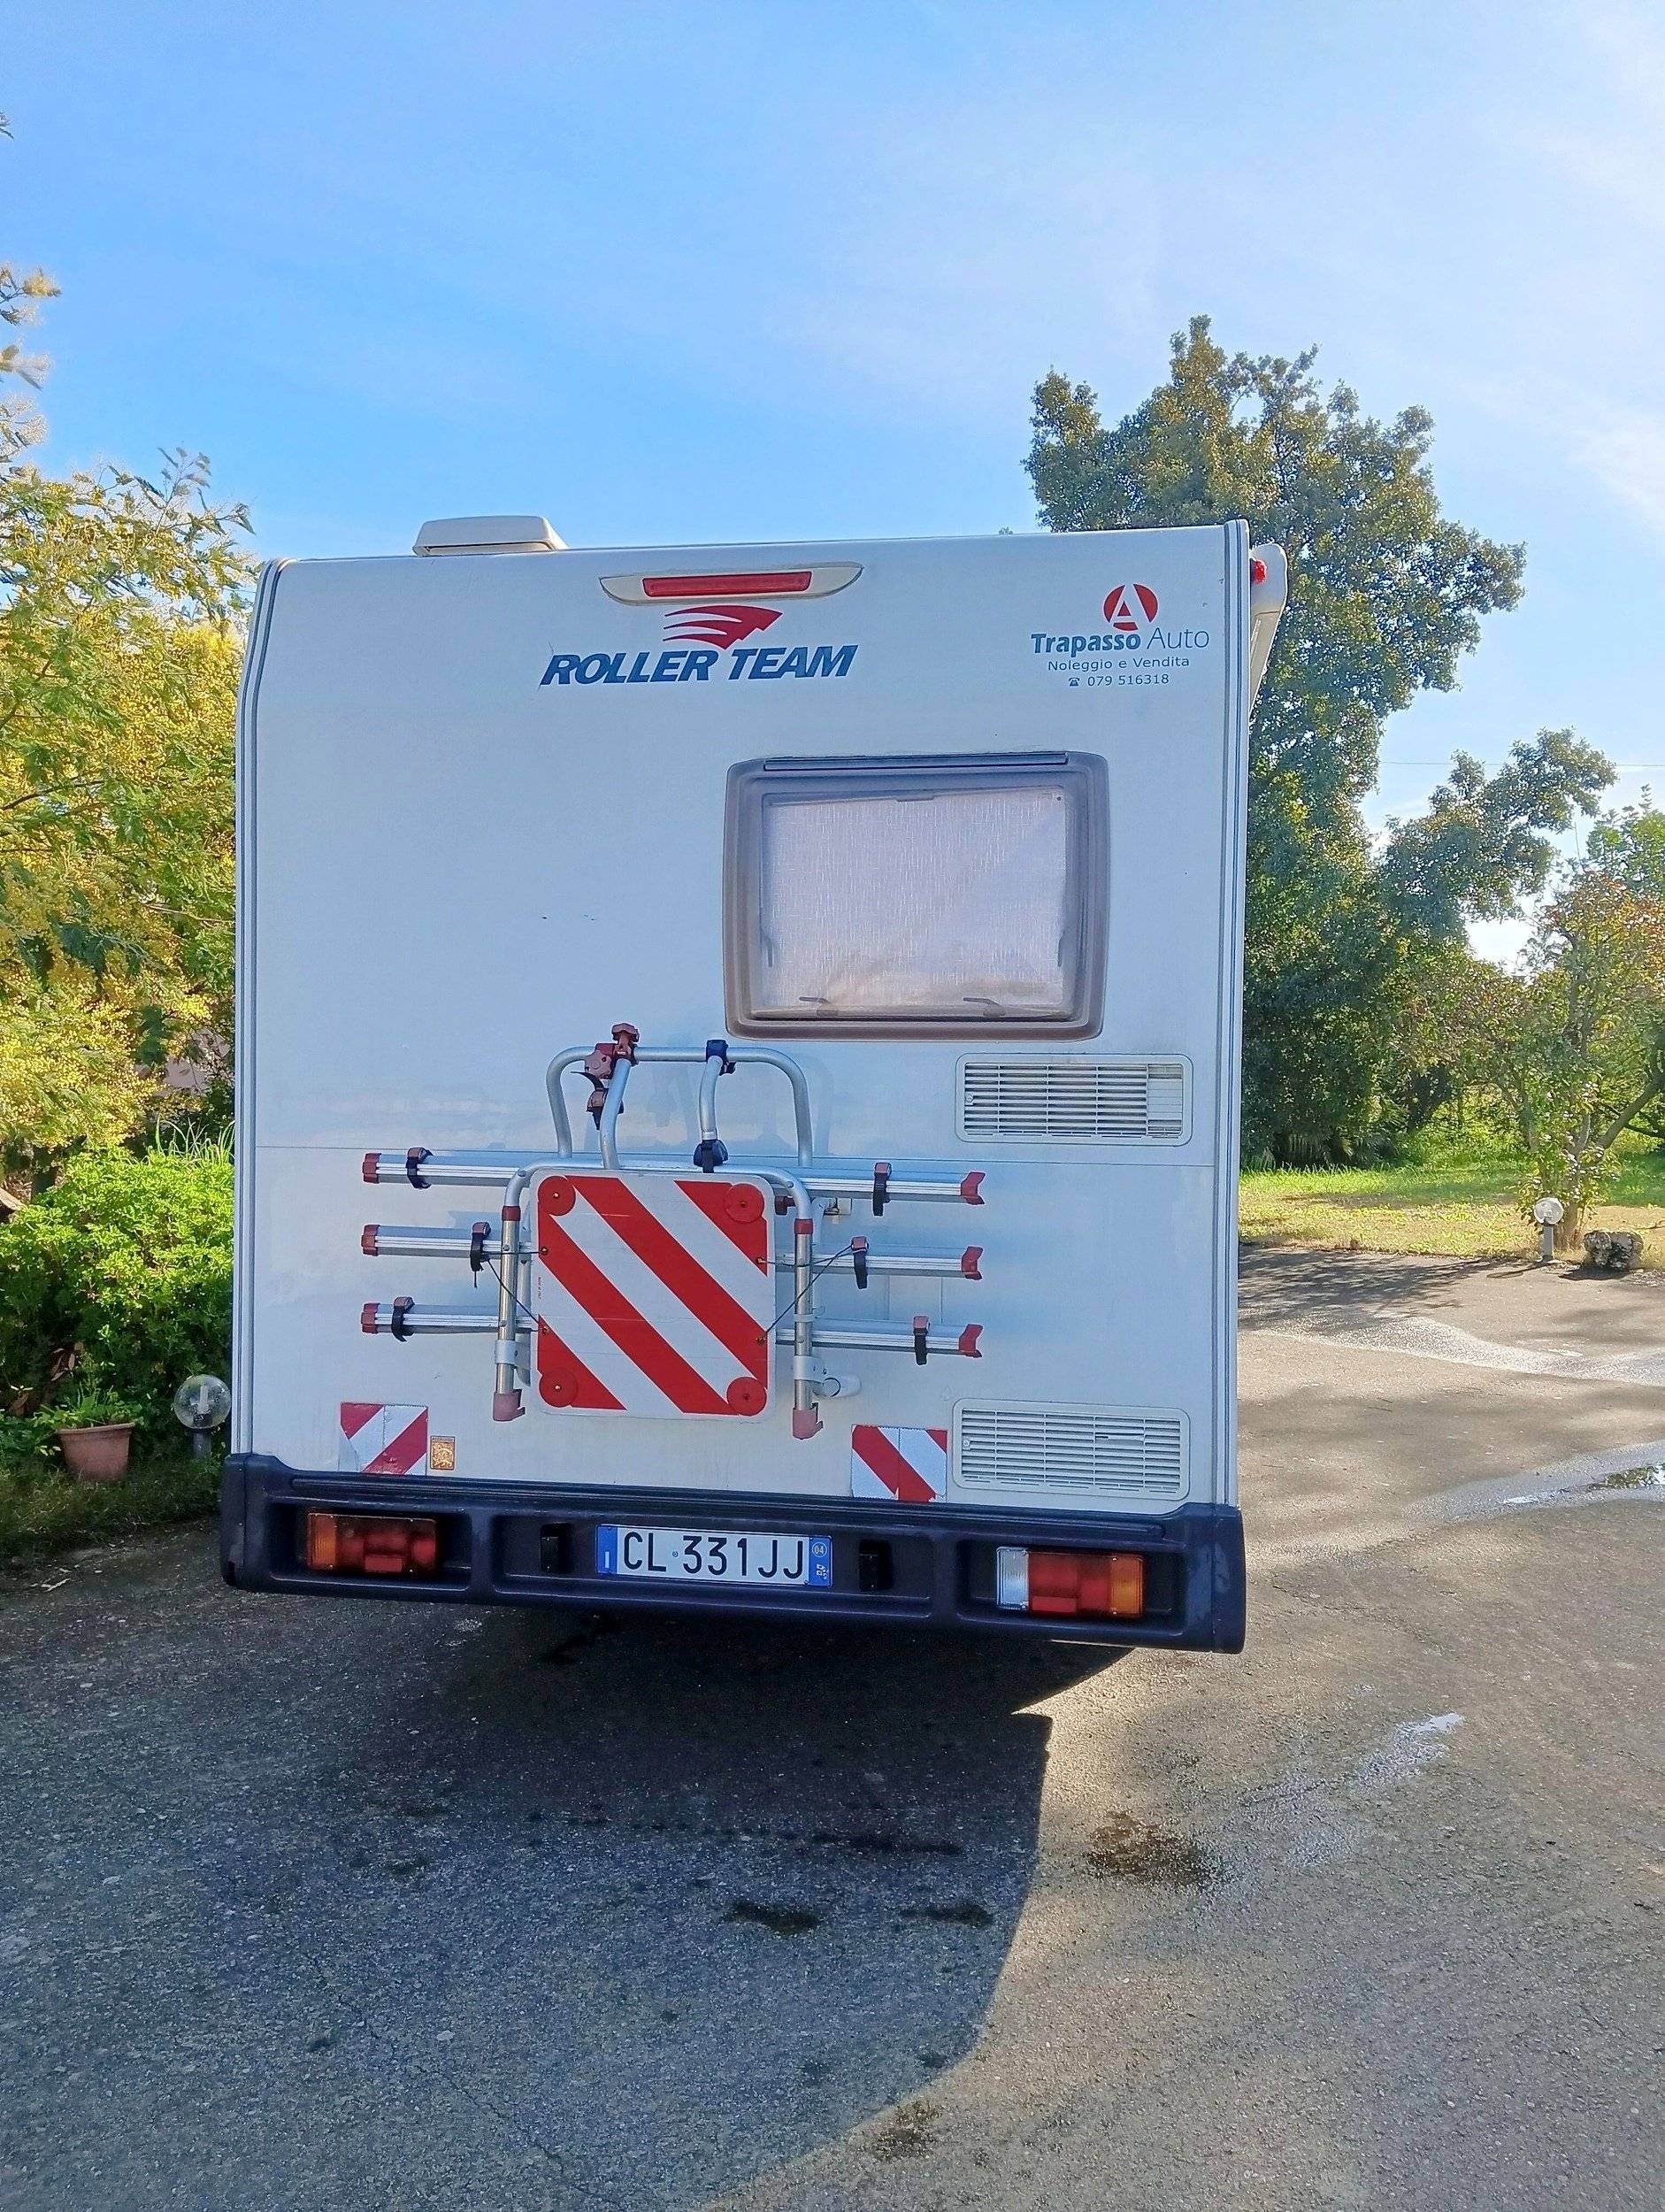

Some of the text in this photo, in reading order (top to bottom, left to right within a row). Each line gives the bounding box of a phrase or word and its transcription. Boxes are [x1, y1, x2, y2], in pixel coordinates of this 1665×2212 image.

[1031, 627, 1209, 657] Trapasso Auto
[540, 645, 858, 686] ROLLER TEAM
[1048, 658, 1113, 672] Noleggio
[1133, 657, 1190, 667] Vendita
[1087, 674, 1169, 686] 079 516318
[624, 1532, 666, 1572] CL
